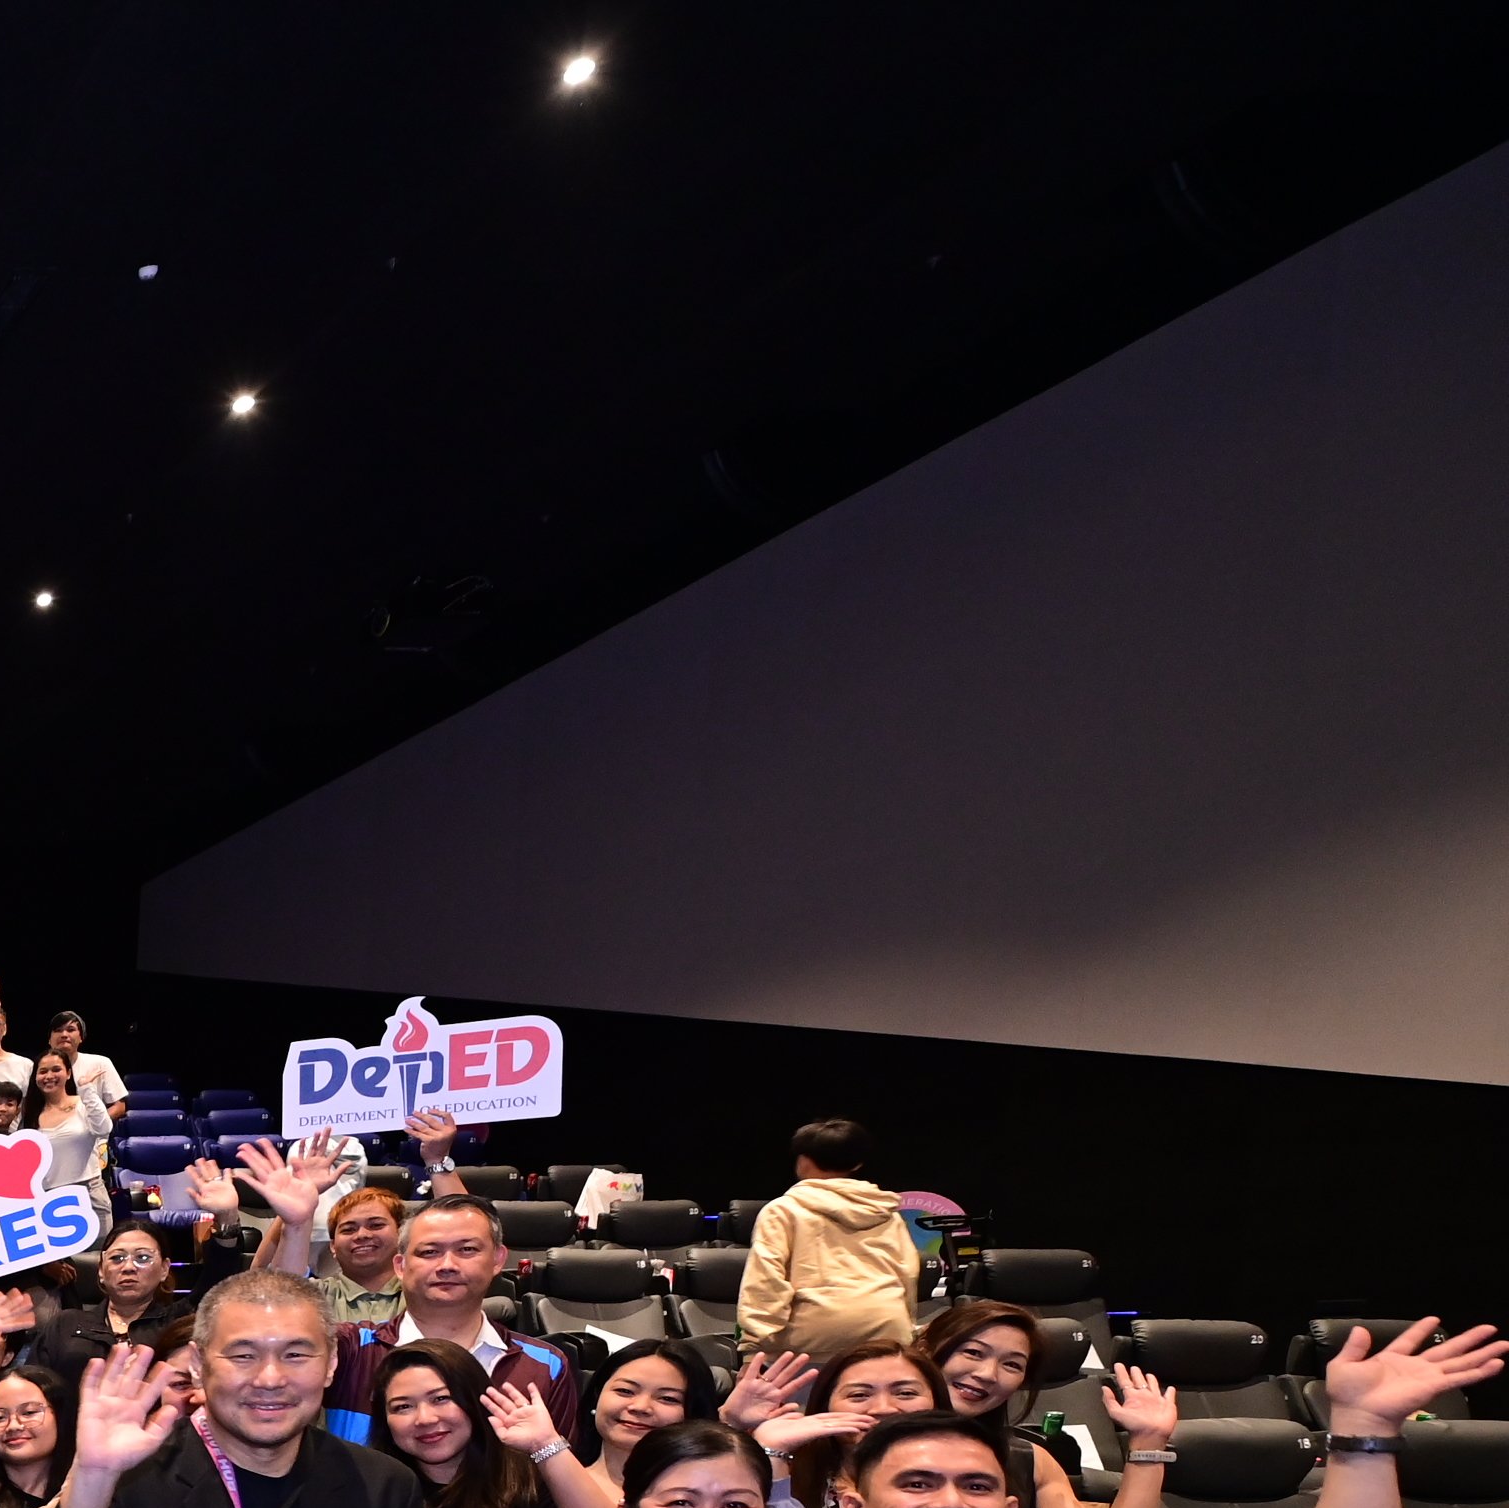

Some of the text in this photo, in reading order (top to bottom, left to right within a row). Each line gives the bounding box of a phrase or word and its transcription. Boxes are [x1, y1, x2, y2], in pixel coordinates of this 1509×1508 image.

[298, 1108, 398, 1128] DEPARTMENT
[444, 1095, 538, 1113] EDUCATION
[1250, 1334, 1264, 1345] 20
